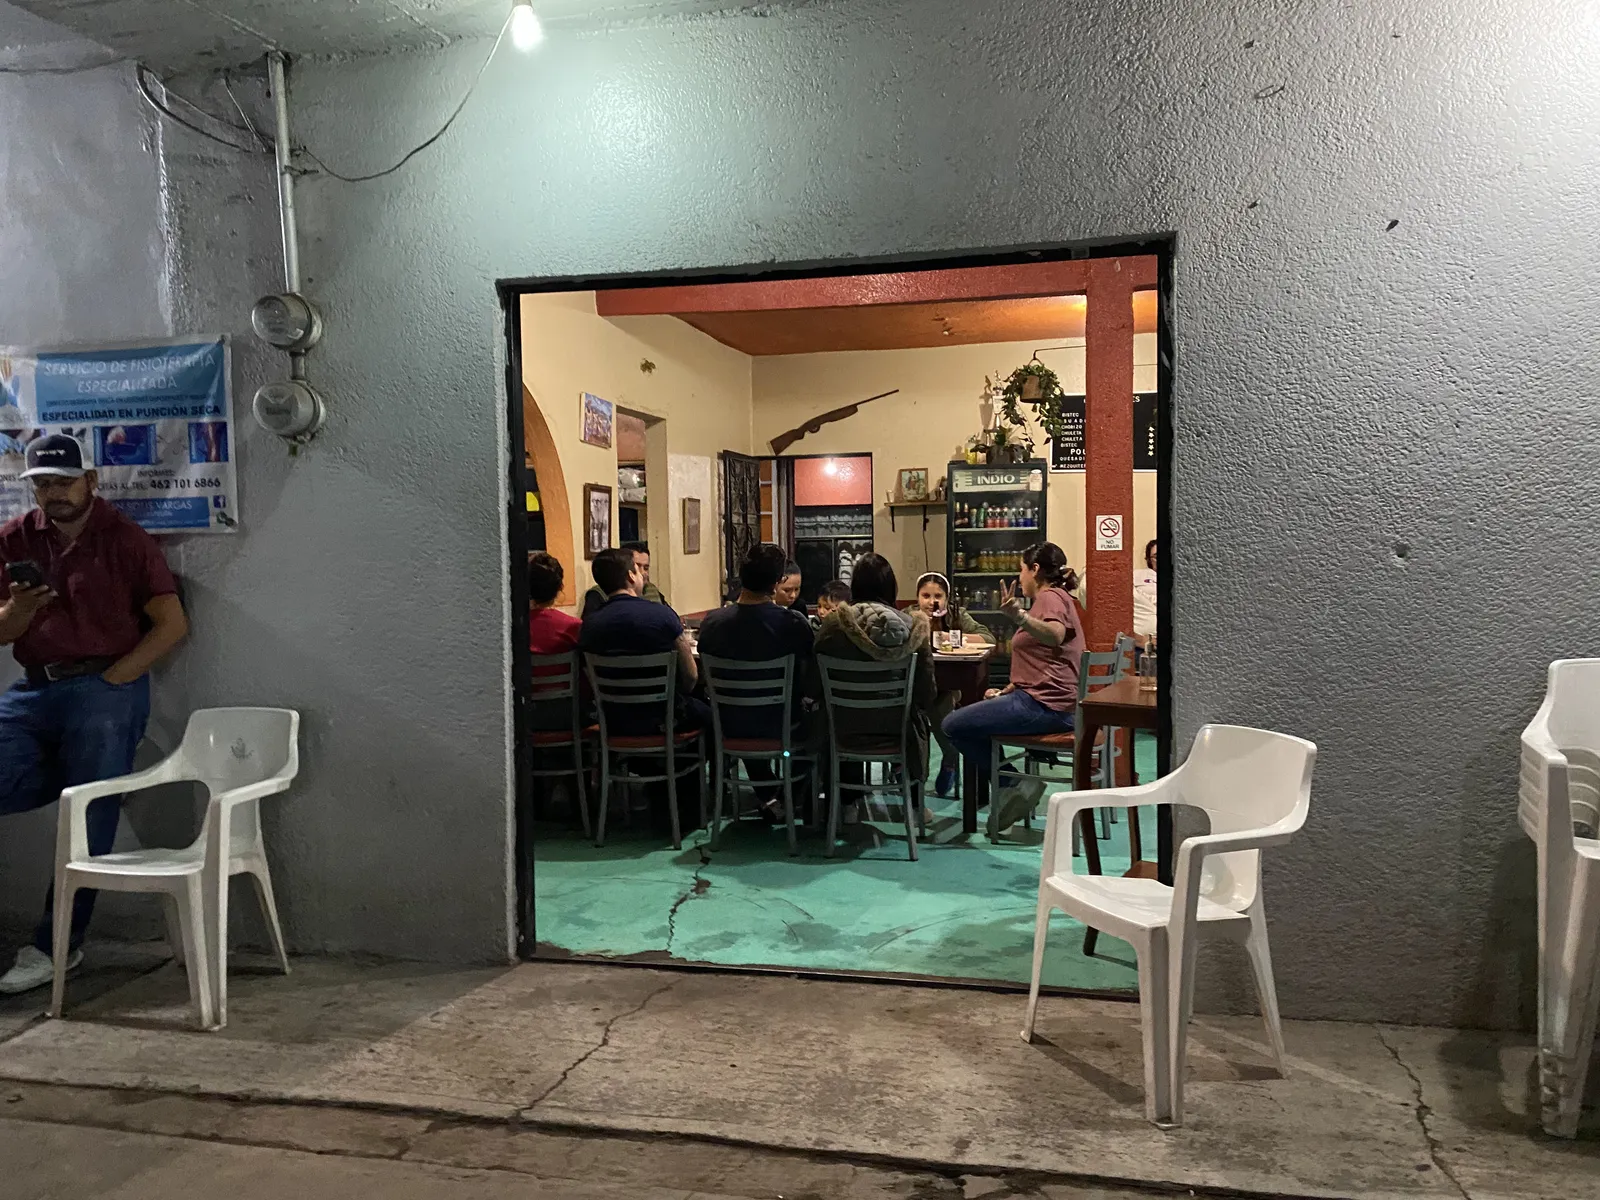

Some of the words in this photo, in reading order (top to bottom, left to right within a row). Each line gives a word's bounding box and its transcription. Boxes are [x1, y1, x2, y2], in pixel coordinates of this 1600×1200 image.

[44, 361, 107, 376] SERVICIO
[110, 361, 127, 373] DE
[78, 376, 177, 393] ESPECIALIZADA
[42, 409, 115, 421] ESPECIALIDAD
[119, 407, 133, 418] EN
[136, 404, 188, 417] PUNCIÓN
[191, 405, 221, 415] SECA
[174, 478, 191, 488] 101
[977, 474, 1016, 485] INDIO
[155, 500, 193, 510] VARGAS
